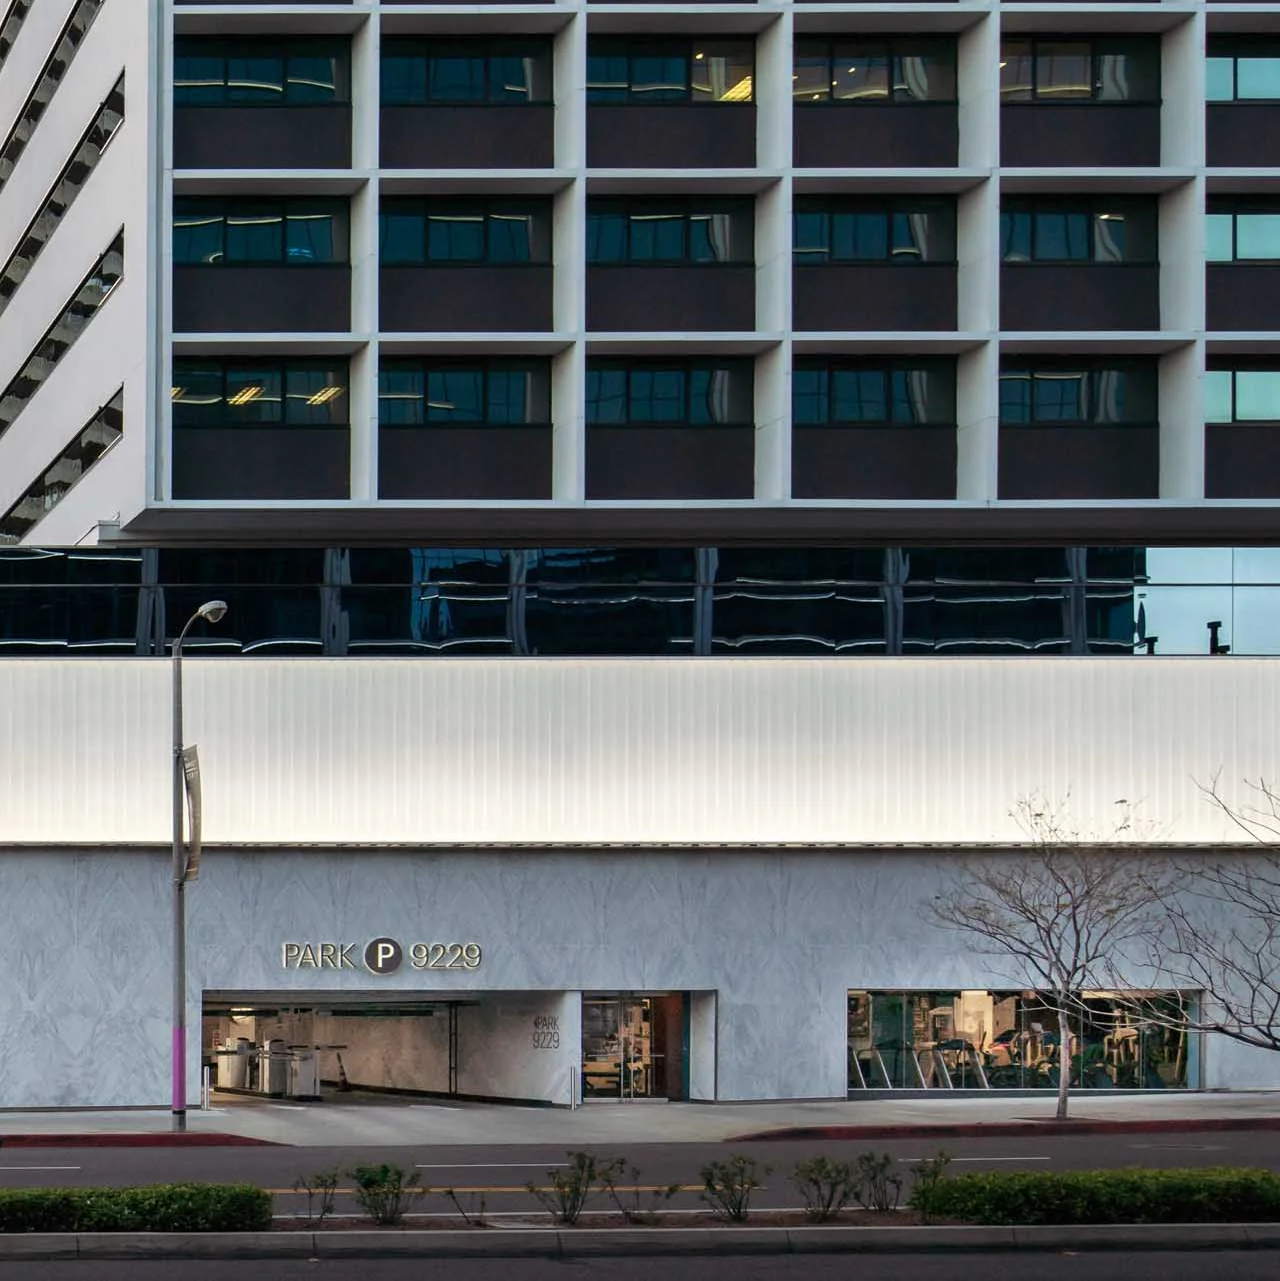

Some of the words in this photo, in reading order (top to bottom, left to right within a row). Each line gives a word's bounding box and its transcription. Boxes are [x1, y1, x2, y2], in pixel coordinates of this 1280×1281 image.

[282, 942, 357, 968] PARK
[377, 943, 395, 968] P
[410, 942, 483, 969] 9229
[533, 1031, 560, 1049] 9229
